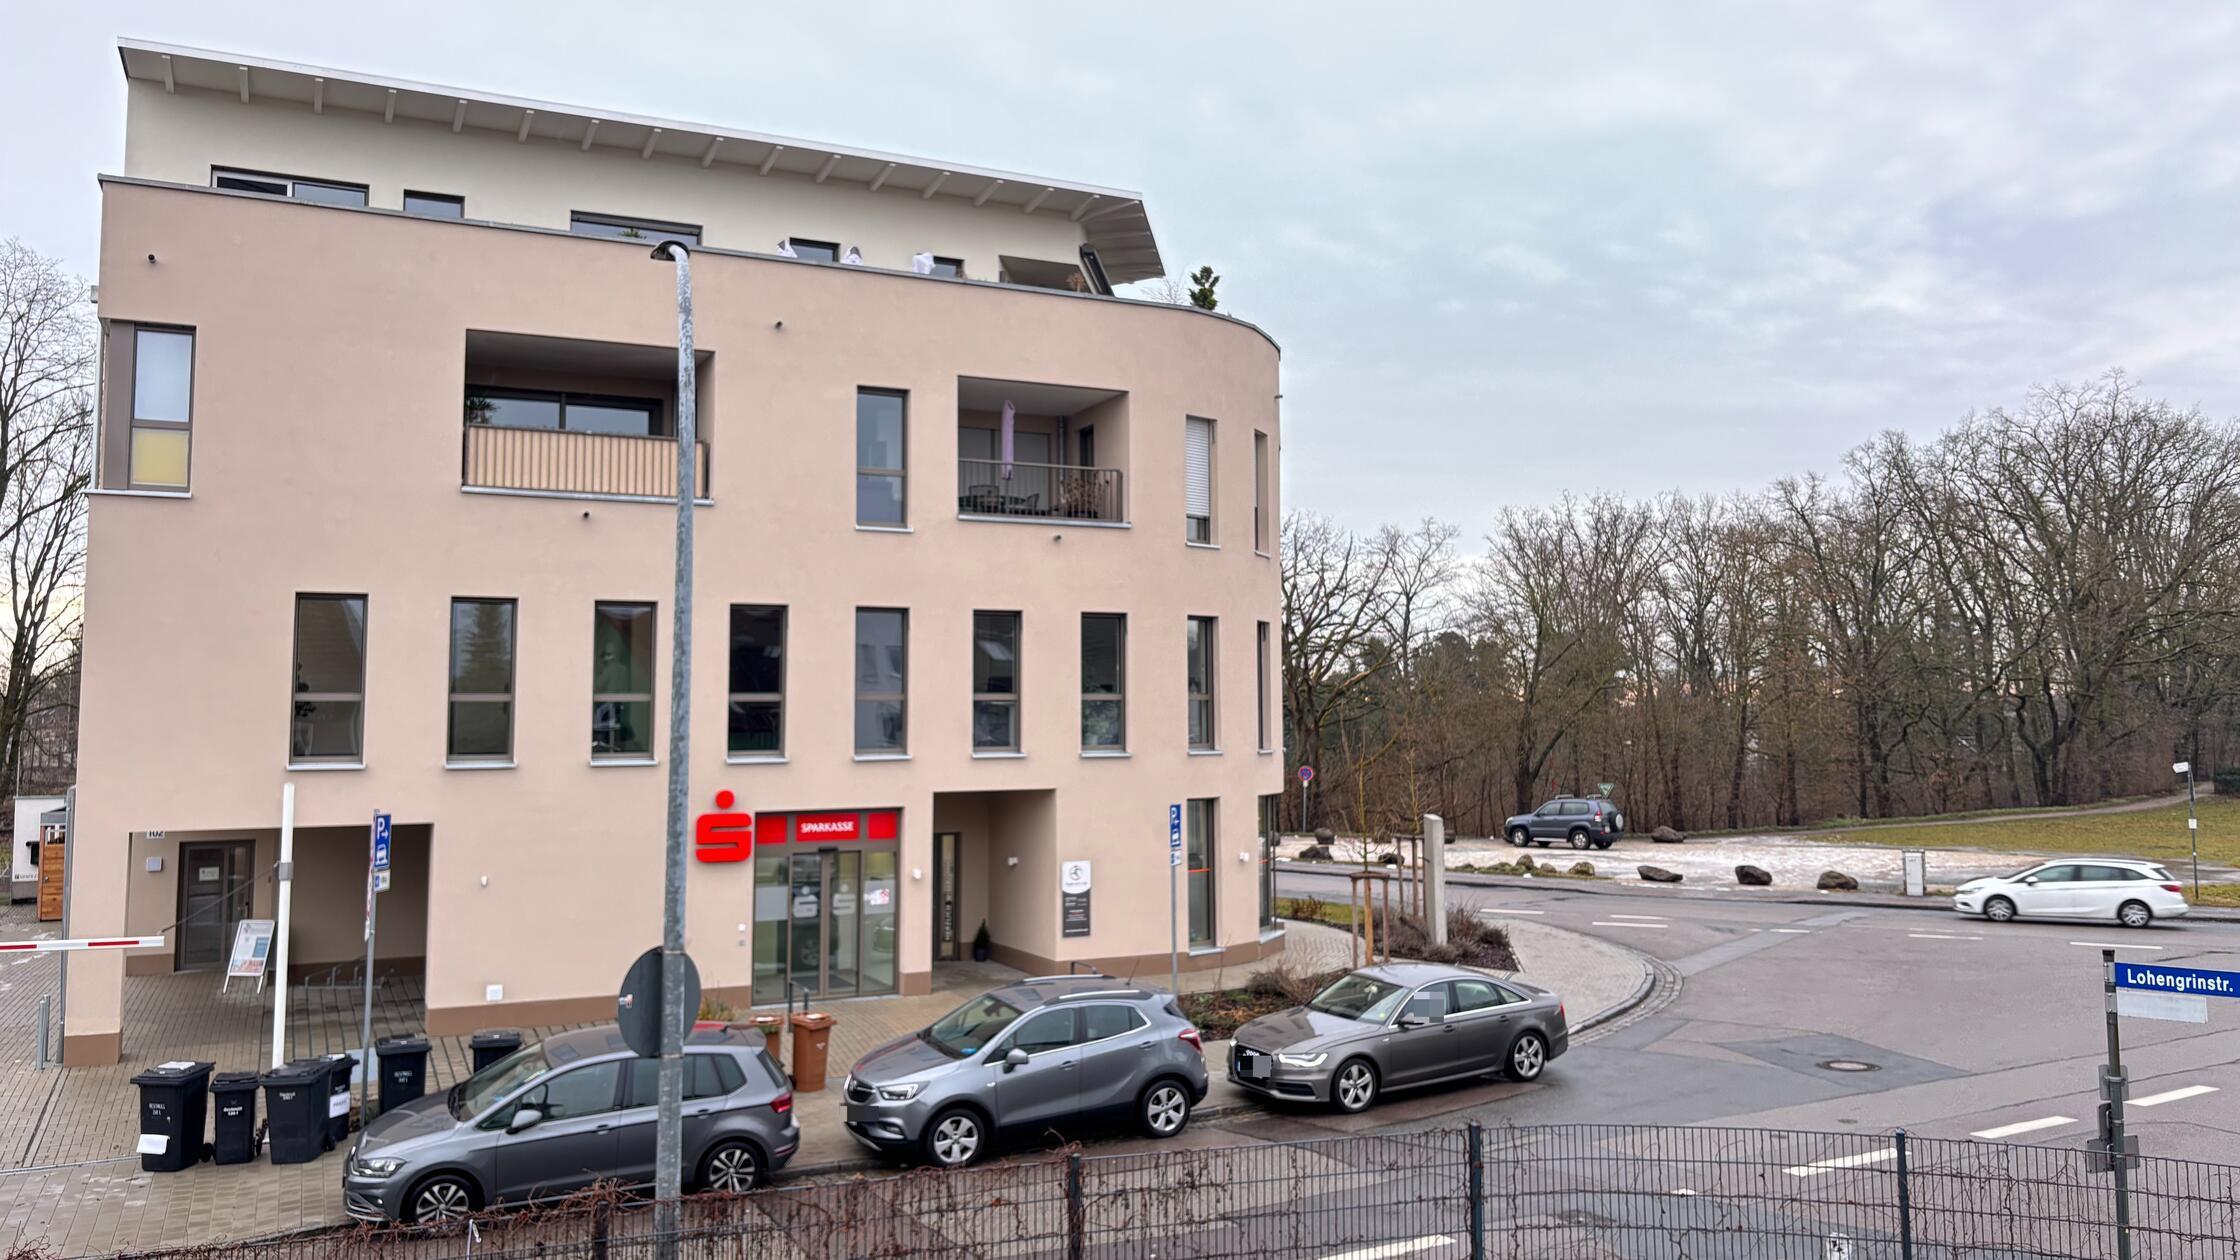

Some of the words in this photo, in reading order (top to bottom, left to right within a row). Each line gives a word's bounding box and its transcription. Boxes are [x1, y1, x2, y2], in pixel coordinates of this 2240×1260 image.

[377, 818, 385, 839] P
[801, 821, 854, 833] SPARKASSE
[2127, 968, 2234, 992] Lohengrinstr.
